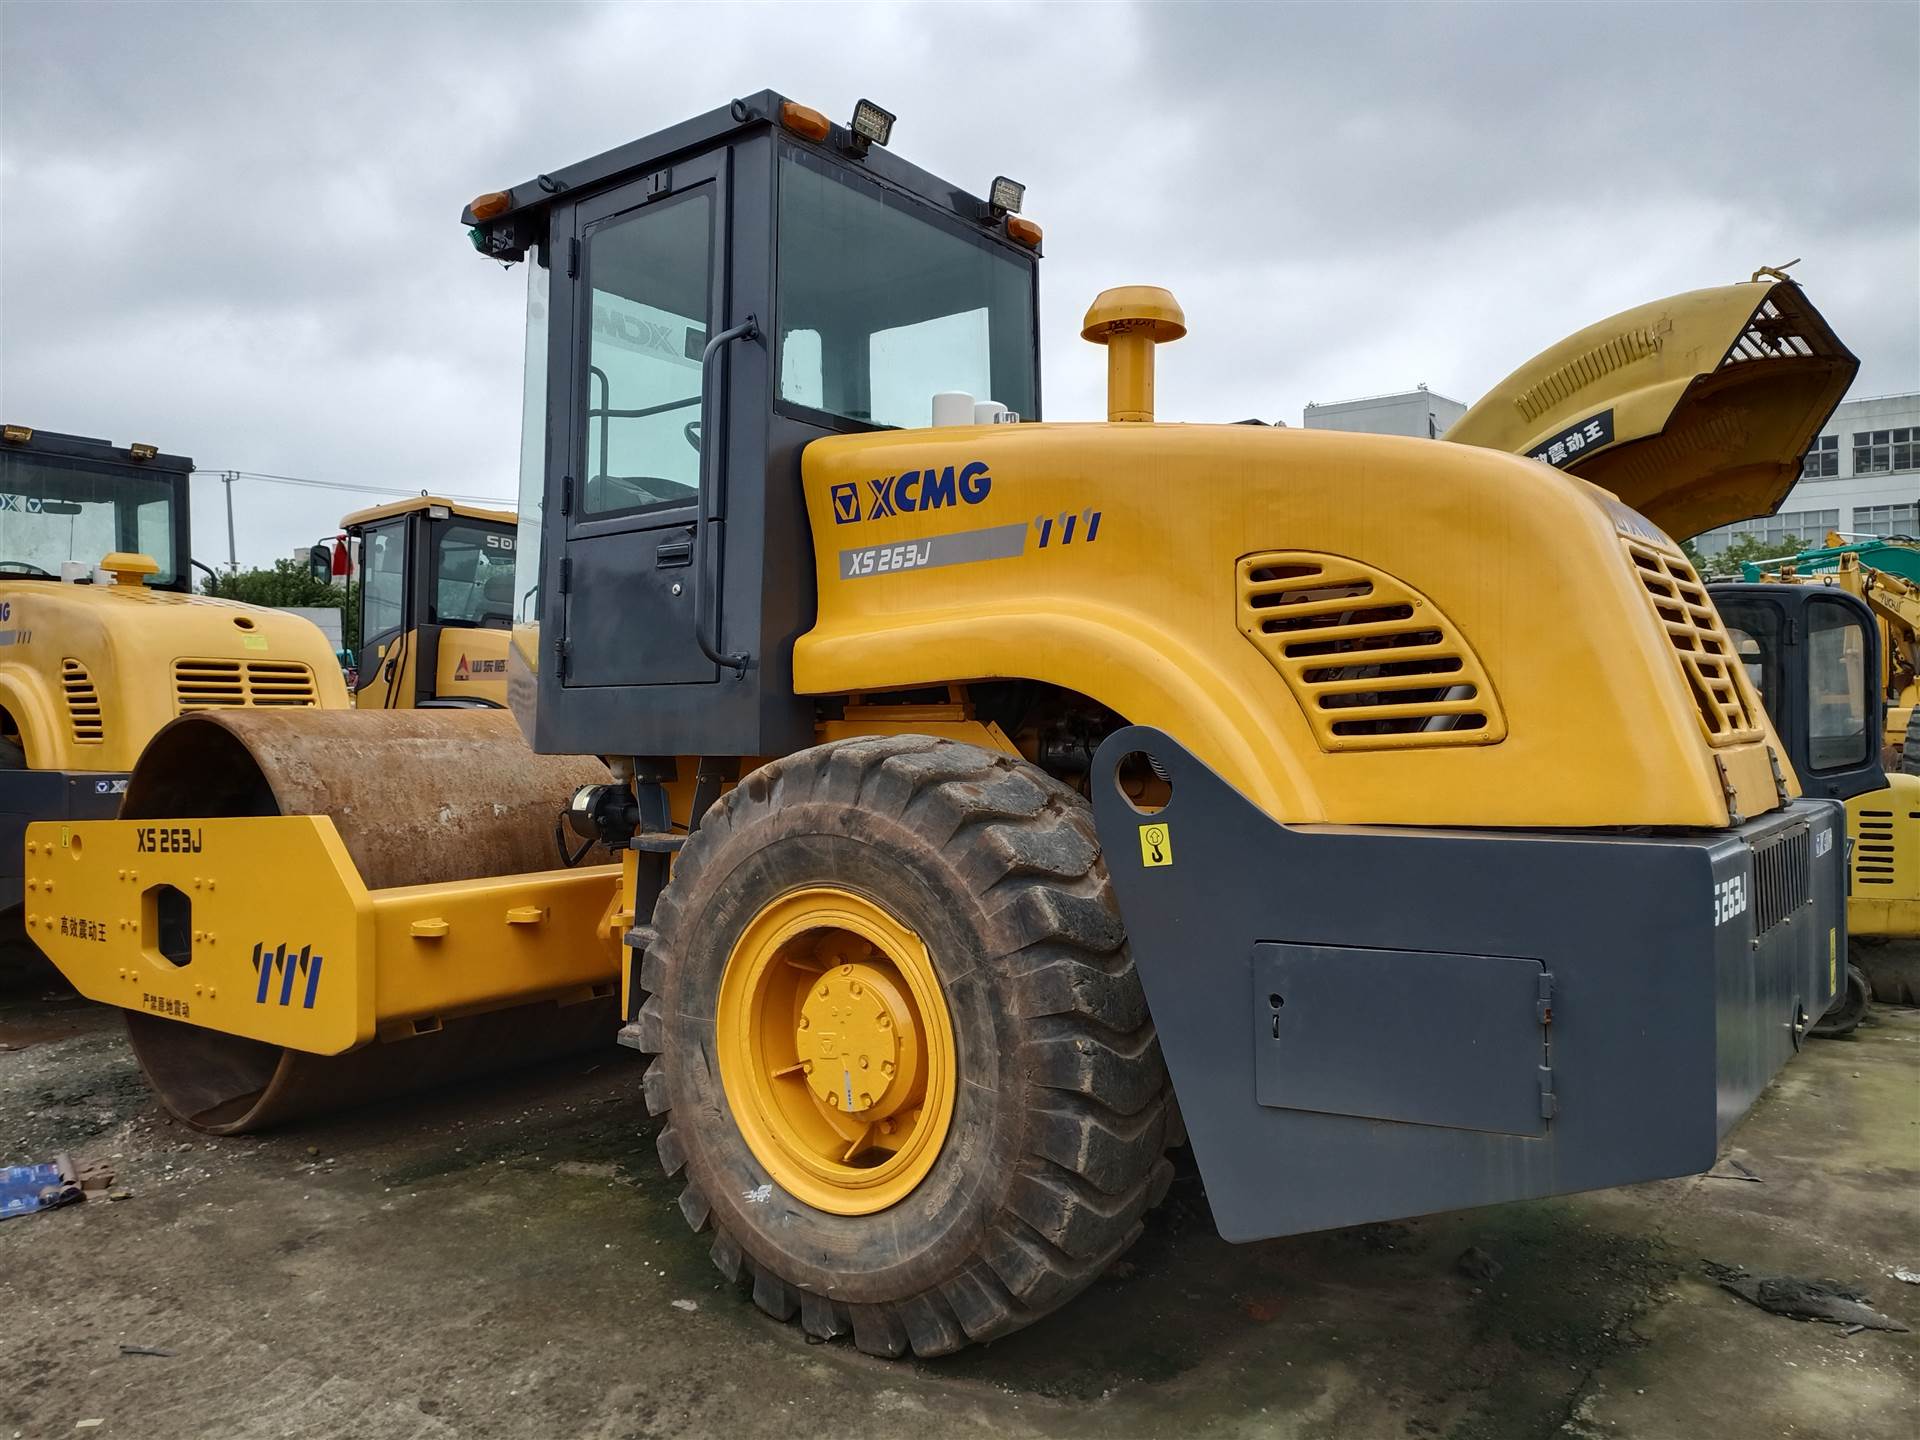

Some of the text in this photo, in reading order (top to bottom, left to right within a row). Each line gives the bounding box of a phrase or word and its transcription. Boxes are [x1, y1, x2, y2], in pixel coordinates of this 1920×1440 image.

[867, 461, 992, 521] XCMG
[848, 541, 932, 576] XS 263J
[136, 828, 202, 853] XS 263J
[1721, 871, 1747, 923] 263J
